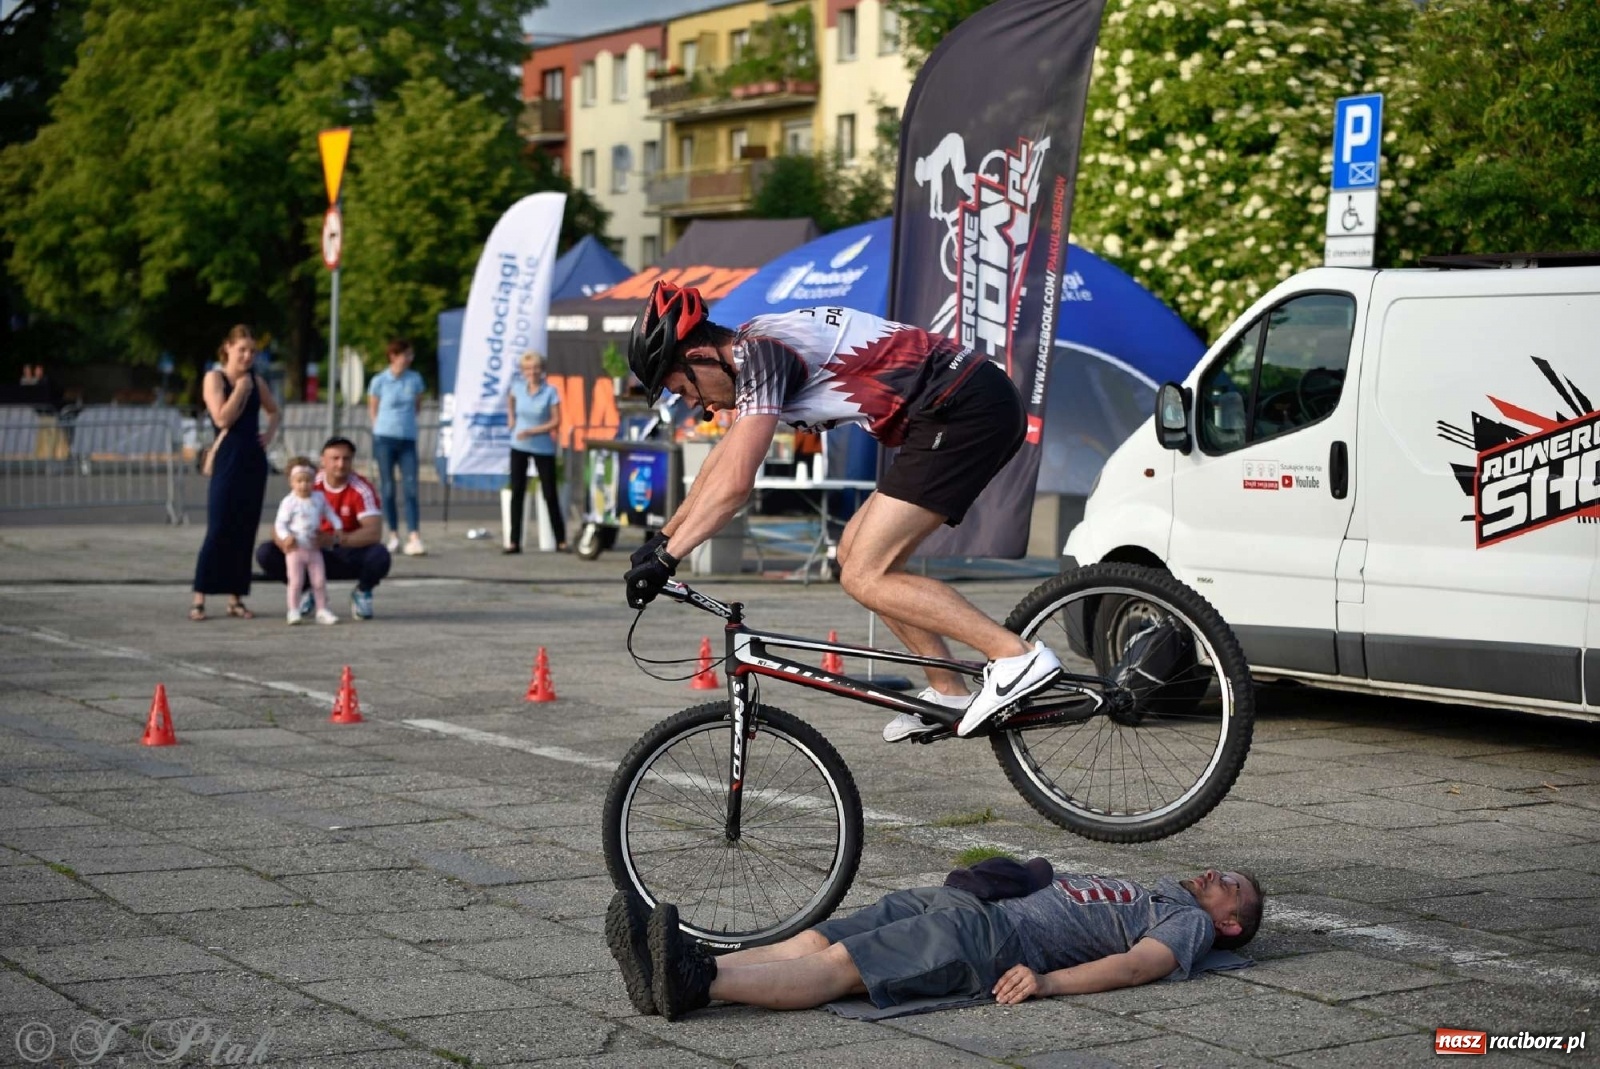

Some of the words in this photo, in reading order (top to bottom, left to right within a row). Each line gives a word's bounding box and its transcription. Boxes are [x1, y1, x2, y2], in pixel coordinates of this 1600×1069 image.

[1342, 104, 1372, 163] P
[961, 212, 980, 350] EROWE
[976, 186, 1012, 369] HOW
[481, 252, 519, 398] Wodociągi
[825, 306, 844, 328] PA
[1295, 475, 1320, 488] YouTube
[1481, 420, 1600, 483] ROWER
